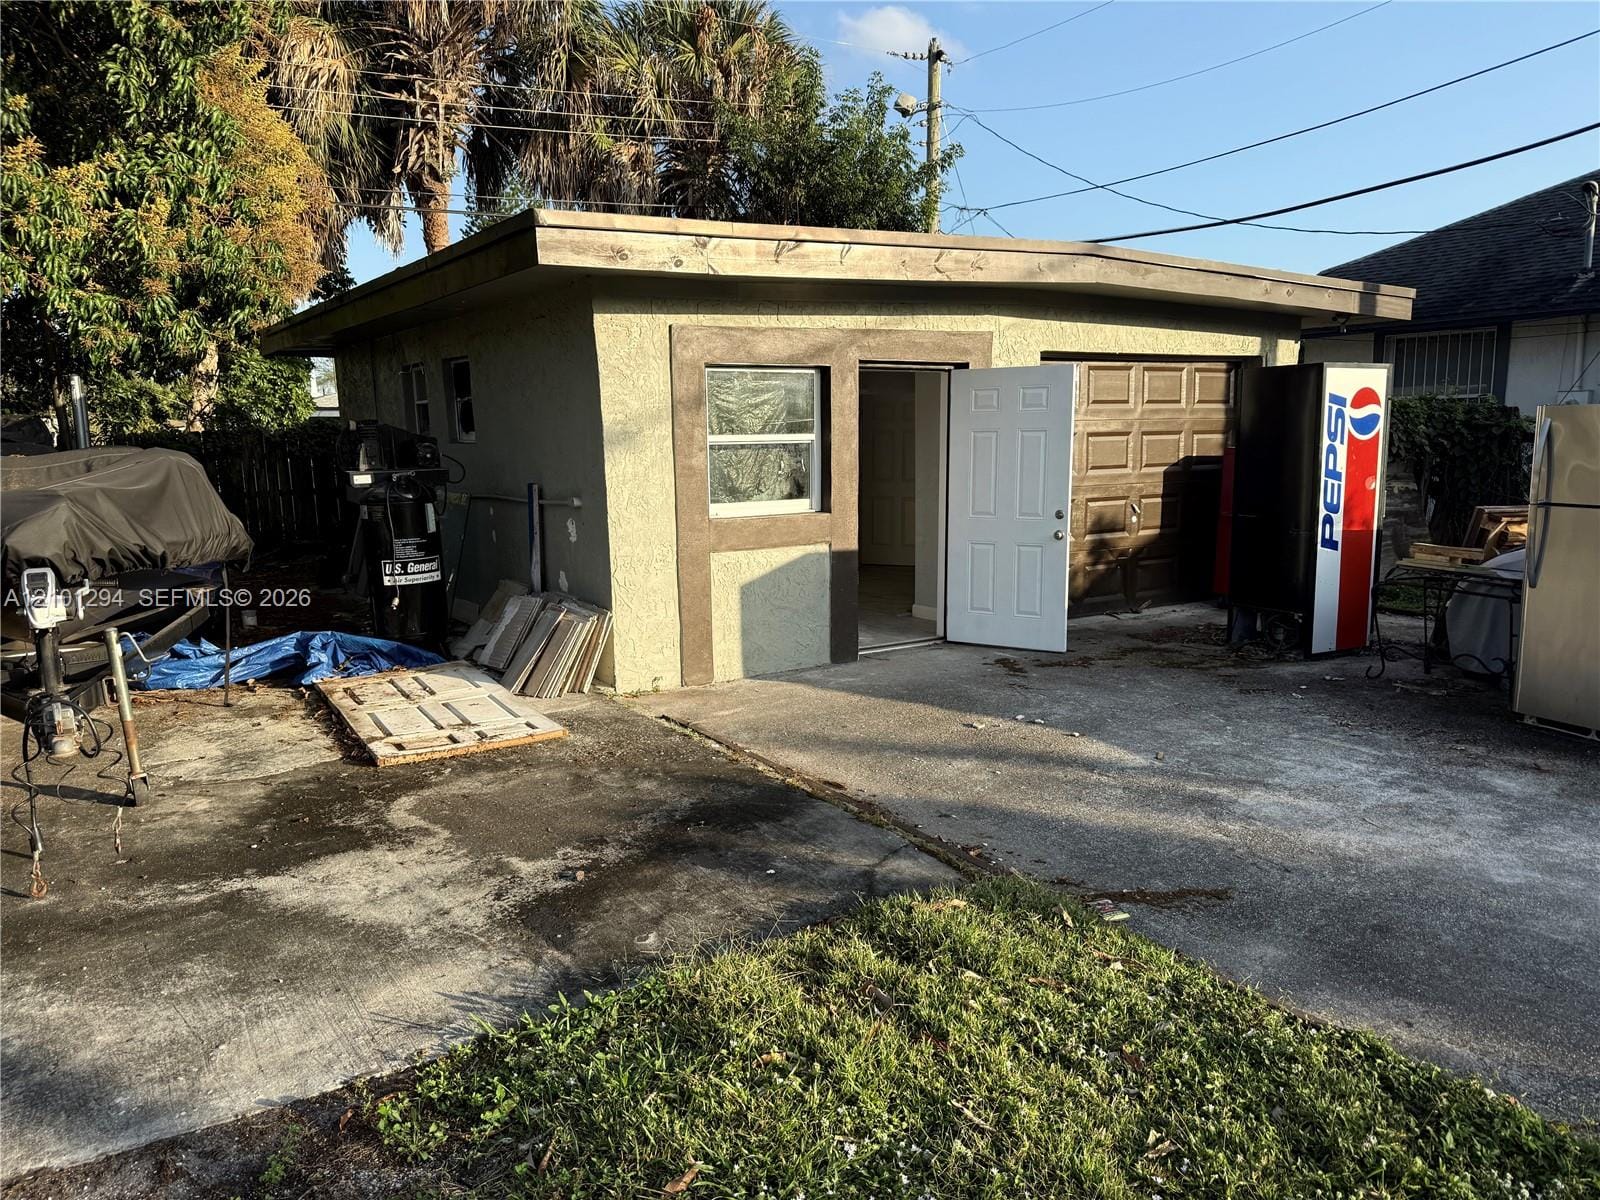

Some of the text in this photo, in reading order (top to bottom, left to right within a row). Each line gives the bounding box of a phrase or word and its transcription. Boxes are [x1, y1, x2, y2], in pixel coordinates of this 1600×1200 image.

[1320, 393, 1347, 551] PEPSI
[385, 559, 438, 574] U.S. General
